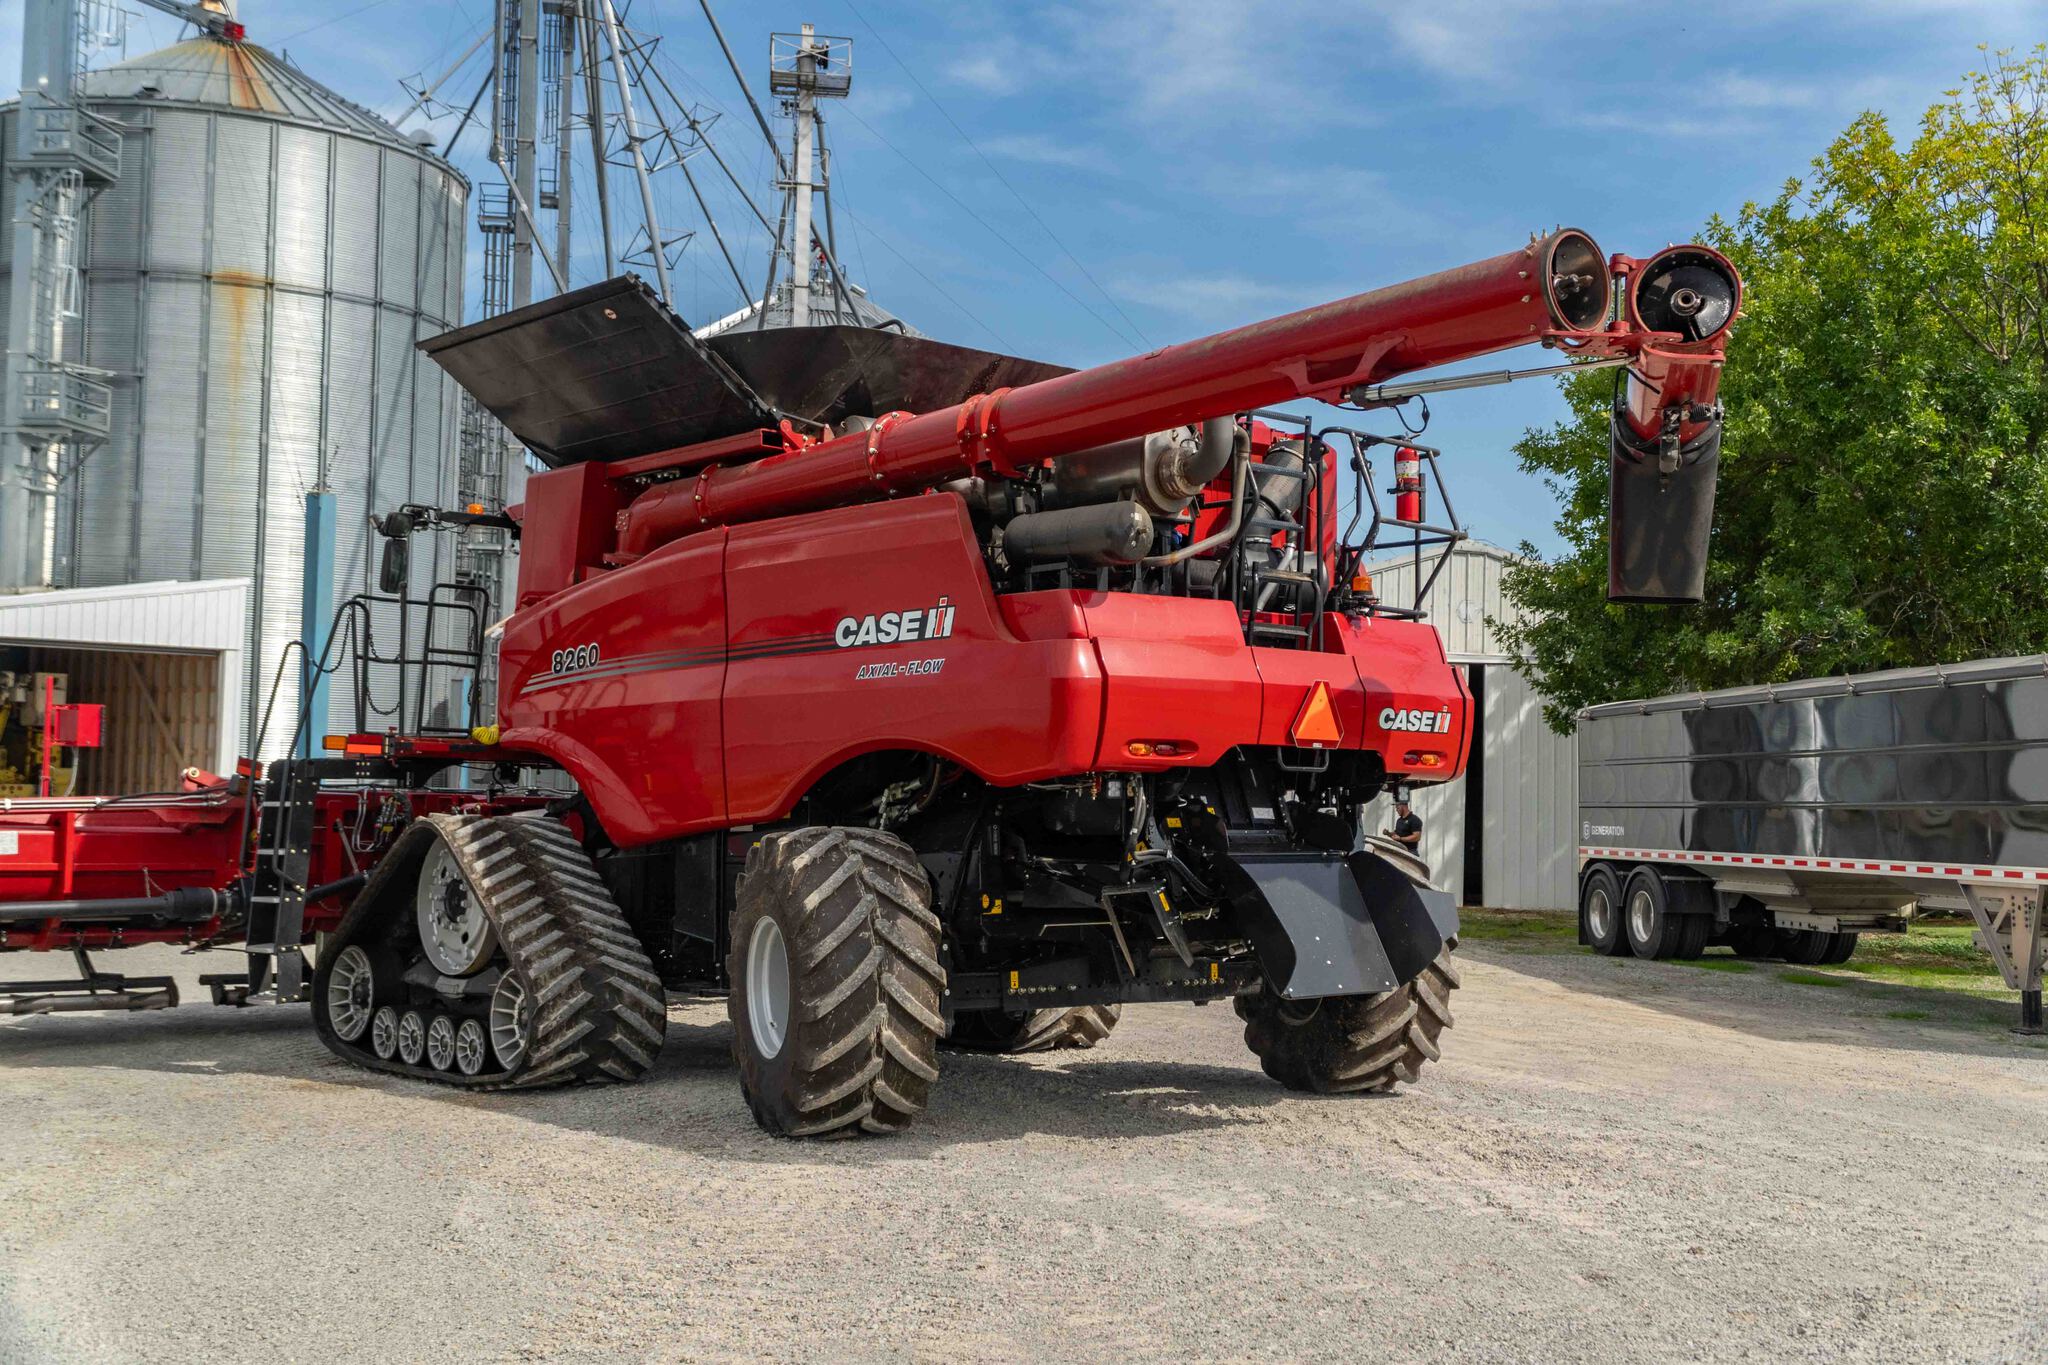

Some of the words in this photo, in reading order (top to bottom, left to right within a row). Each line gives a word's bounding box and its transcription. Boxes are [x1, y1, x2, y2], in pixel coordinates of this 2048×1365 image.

[835, 609, 923, 648] CASE
[551, 642, 600, 674] 8260
[855, 658, 945, 680] AXIAL-FLOW
[1379, 707, 1434, 732] CASE
[1591, 825, 1625, 836] GENERATION
